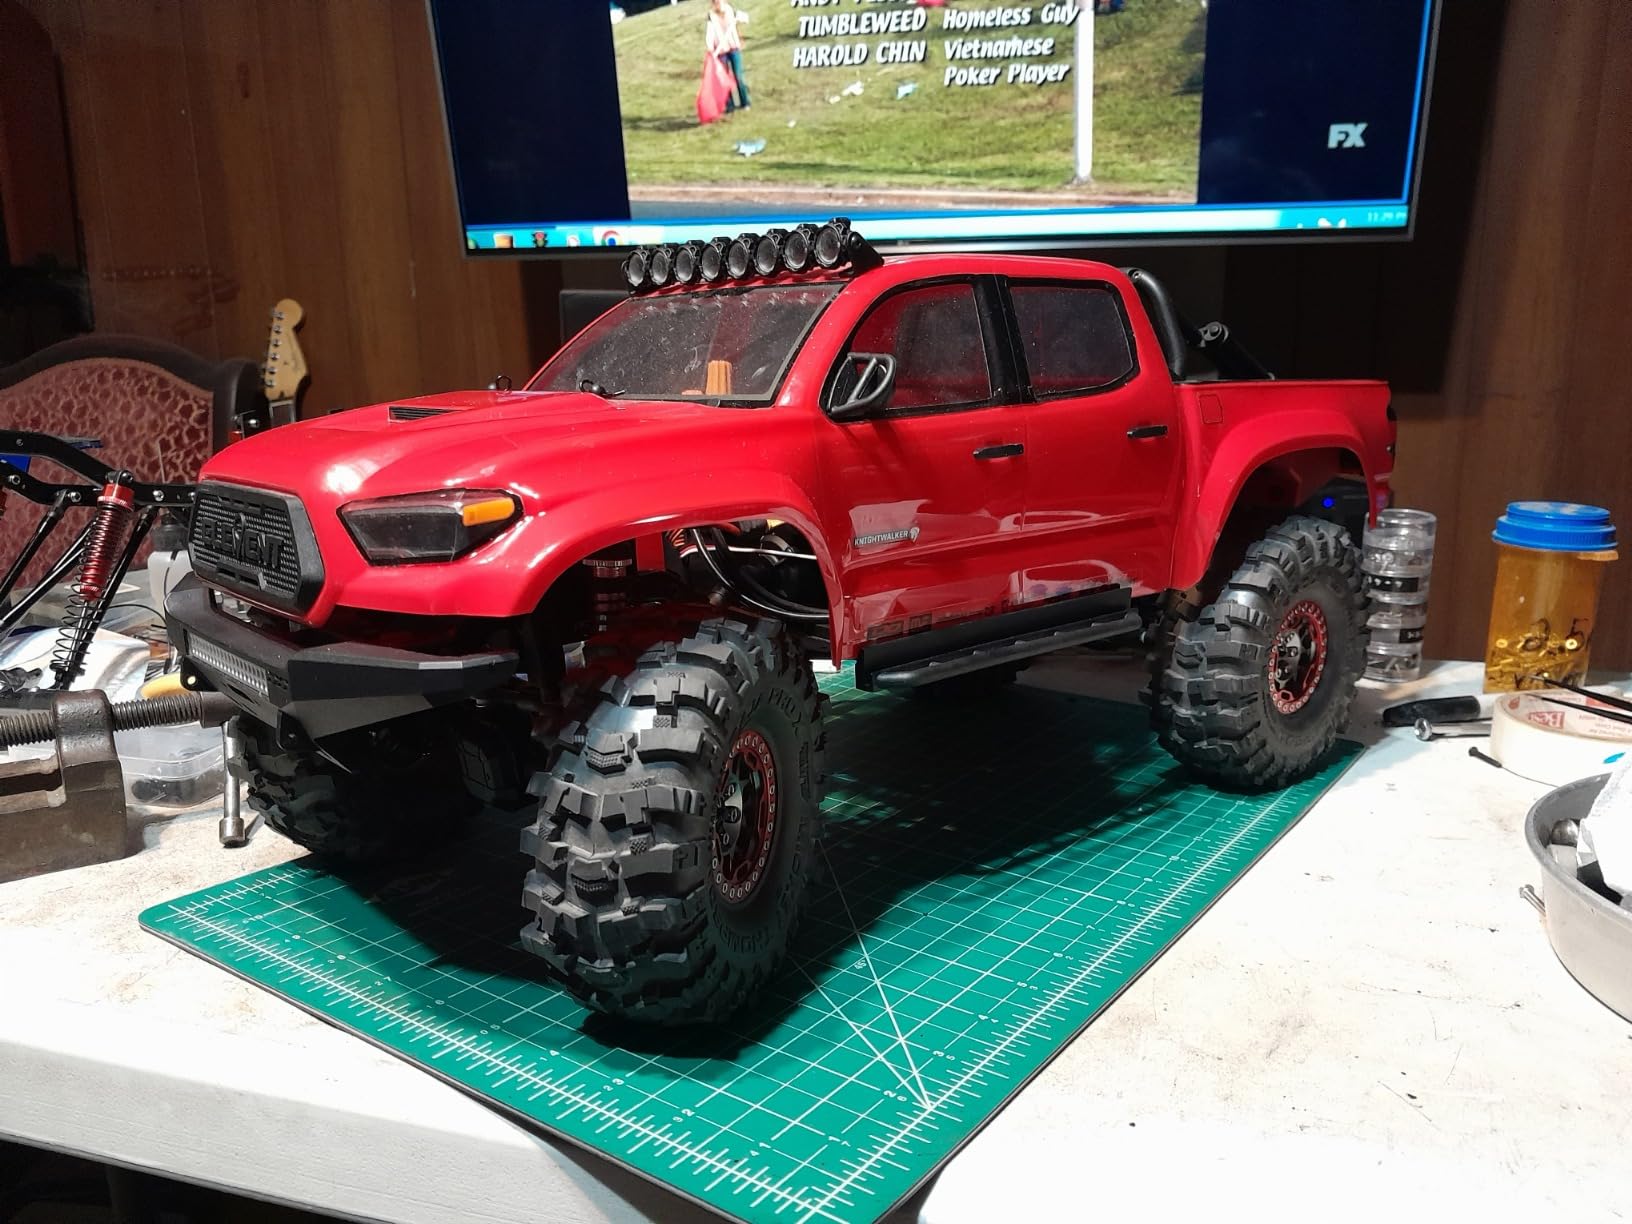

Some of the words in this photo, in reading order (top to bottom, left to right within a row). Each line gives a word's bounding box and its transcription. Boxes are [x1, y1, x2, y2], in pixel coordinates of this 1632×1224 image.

[798, 8, 927, 38] TUMBLEWEED
[943, 6, 1031, 32] Homeless
[1041, 3, 1080, 26] Guy
[793, 43, 868, 68] HAROLD
[876, 40, 927, 64] CHIN
[944, 37, 1055, 61] Vietnamese
[944, 65, 1002, 87] Poker
[1007, 63, 1071, 86] Player
[1328, 123, 1368, 149] FX
[854, 530, 909, 547] KNIGHTWALKER
